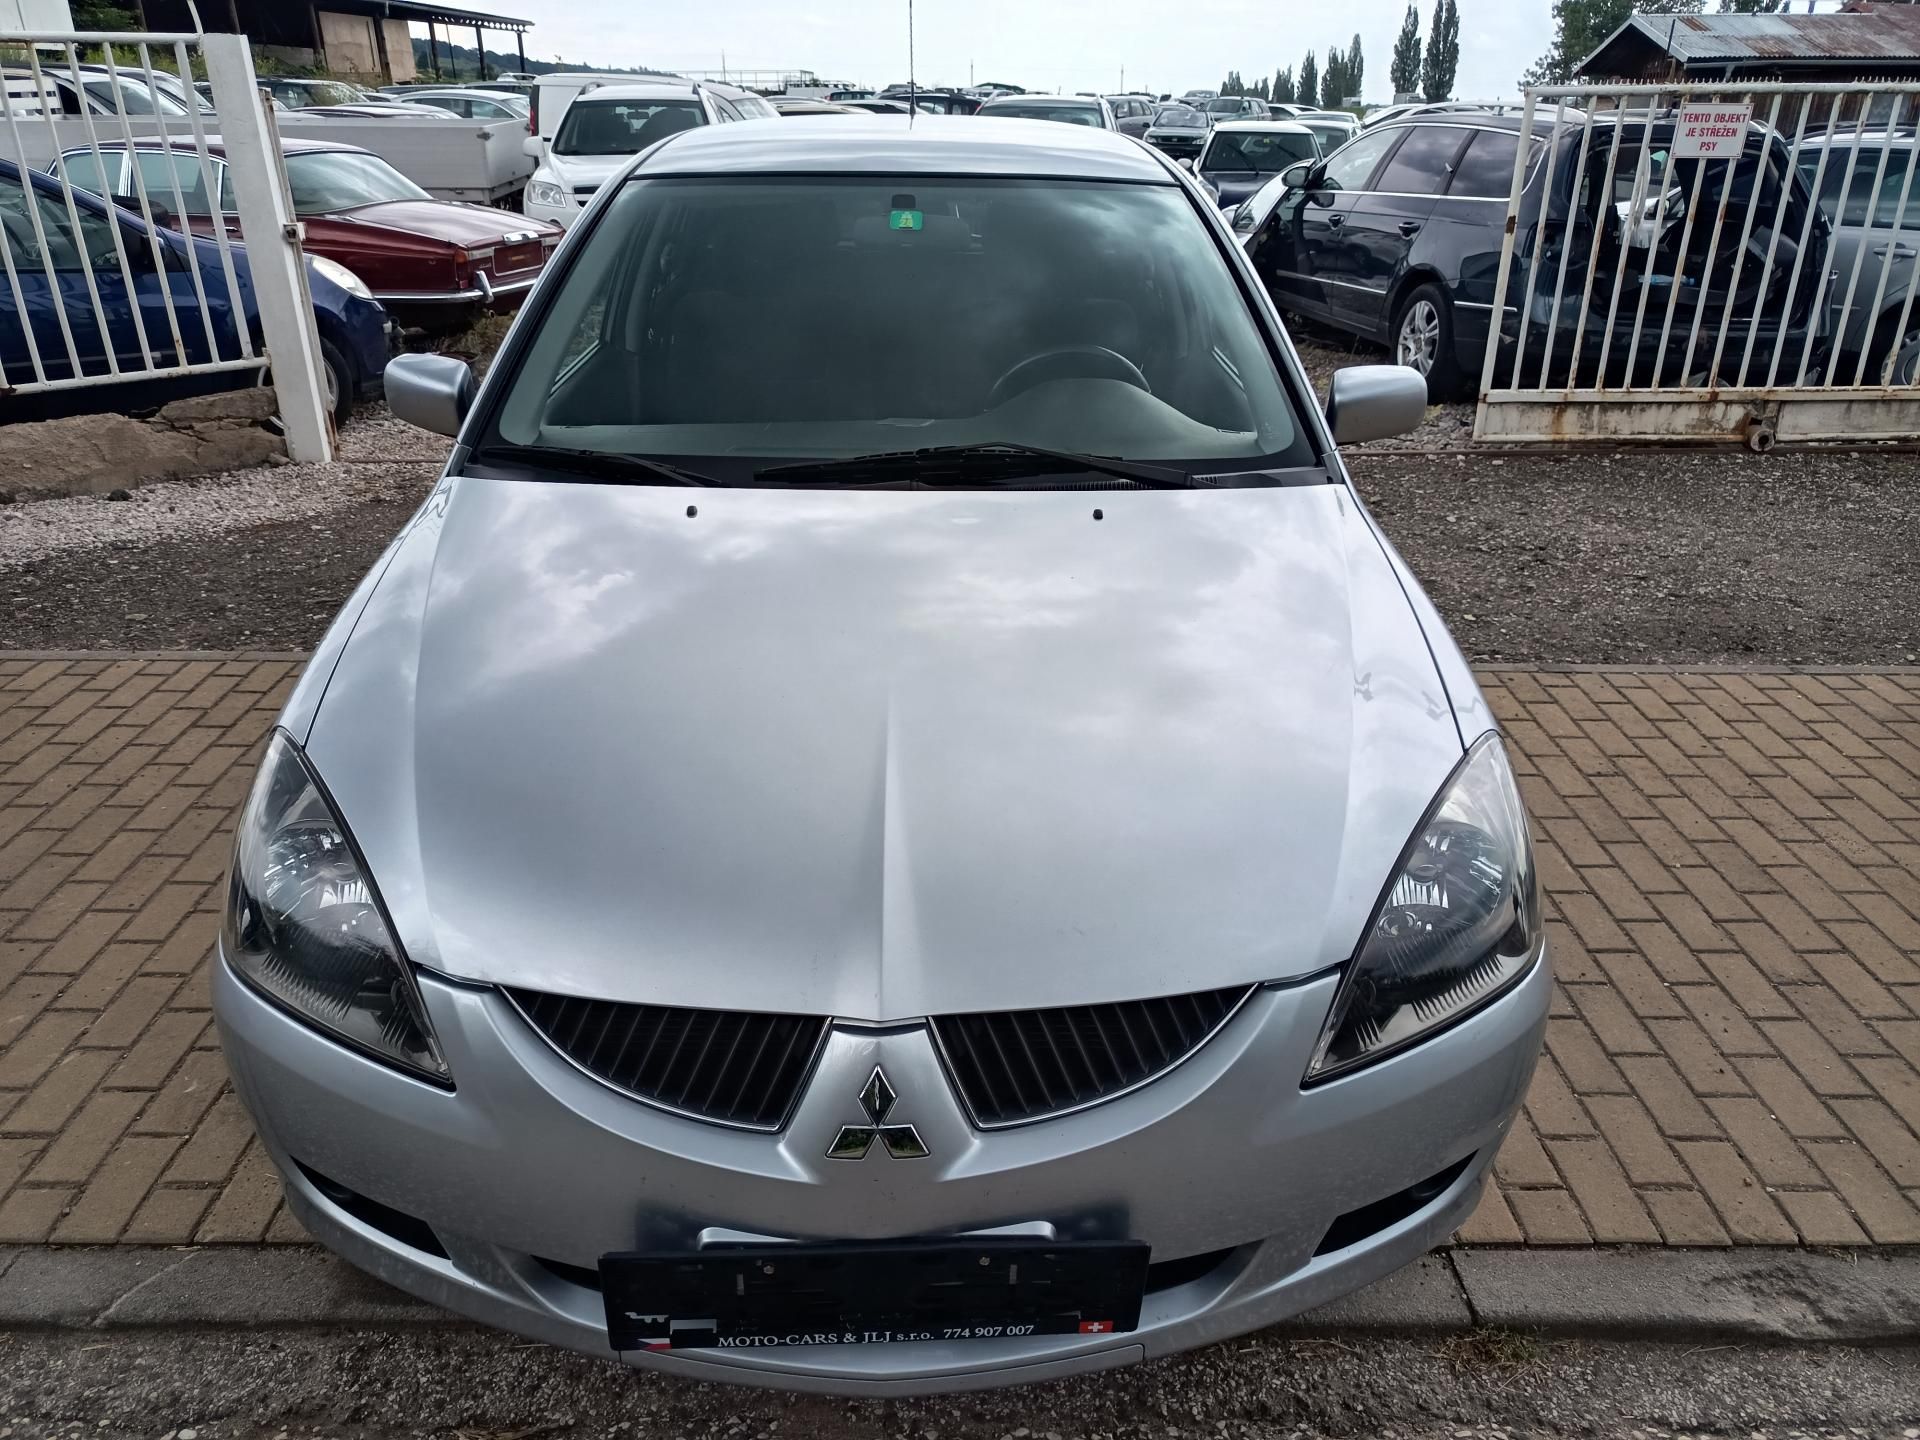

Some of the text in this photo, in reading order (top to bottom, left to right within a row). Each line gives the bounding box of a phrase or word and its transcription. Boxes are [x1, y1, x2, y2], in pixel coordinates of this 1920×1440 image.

[1683, 113, 1747, 122] TENTO OBJEKT
[1685, 124, 1737, 137] JE STŘEŽEN
[1699, 142, 1717, 151] PSY
[718, 1325, 1034, 1347] MOTO-CARS & JLJ s.r.o. 774 907 007
